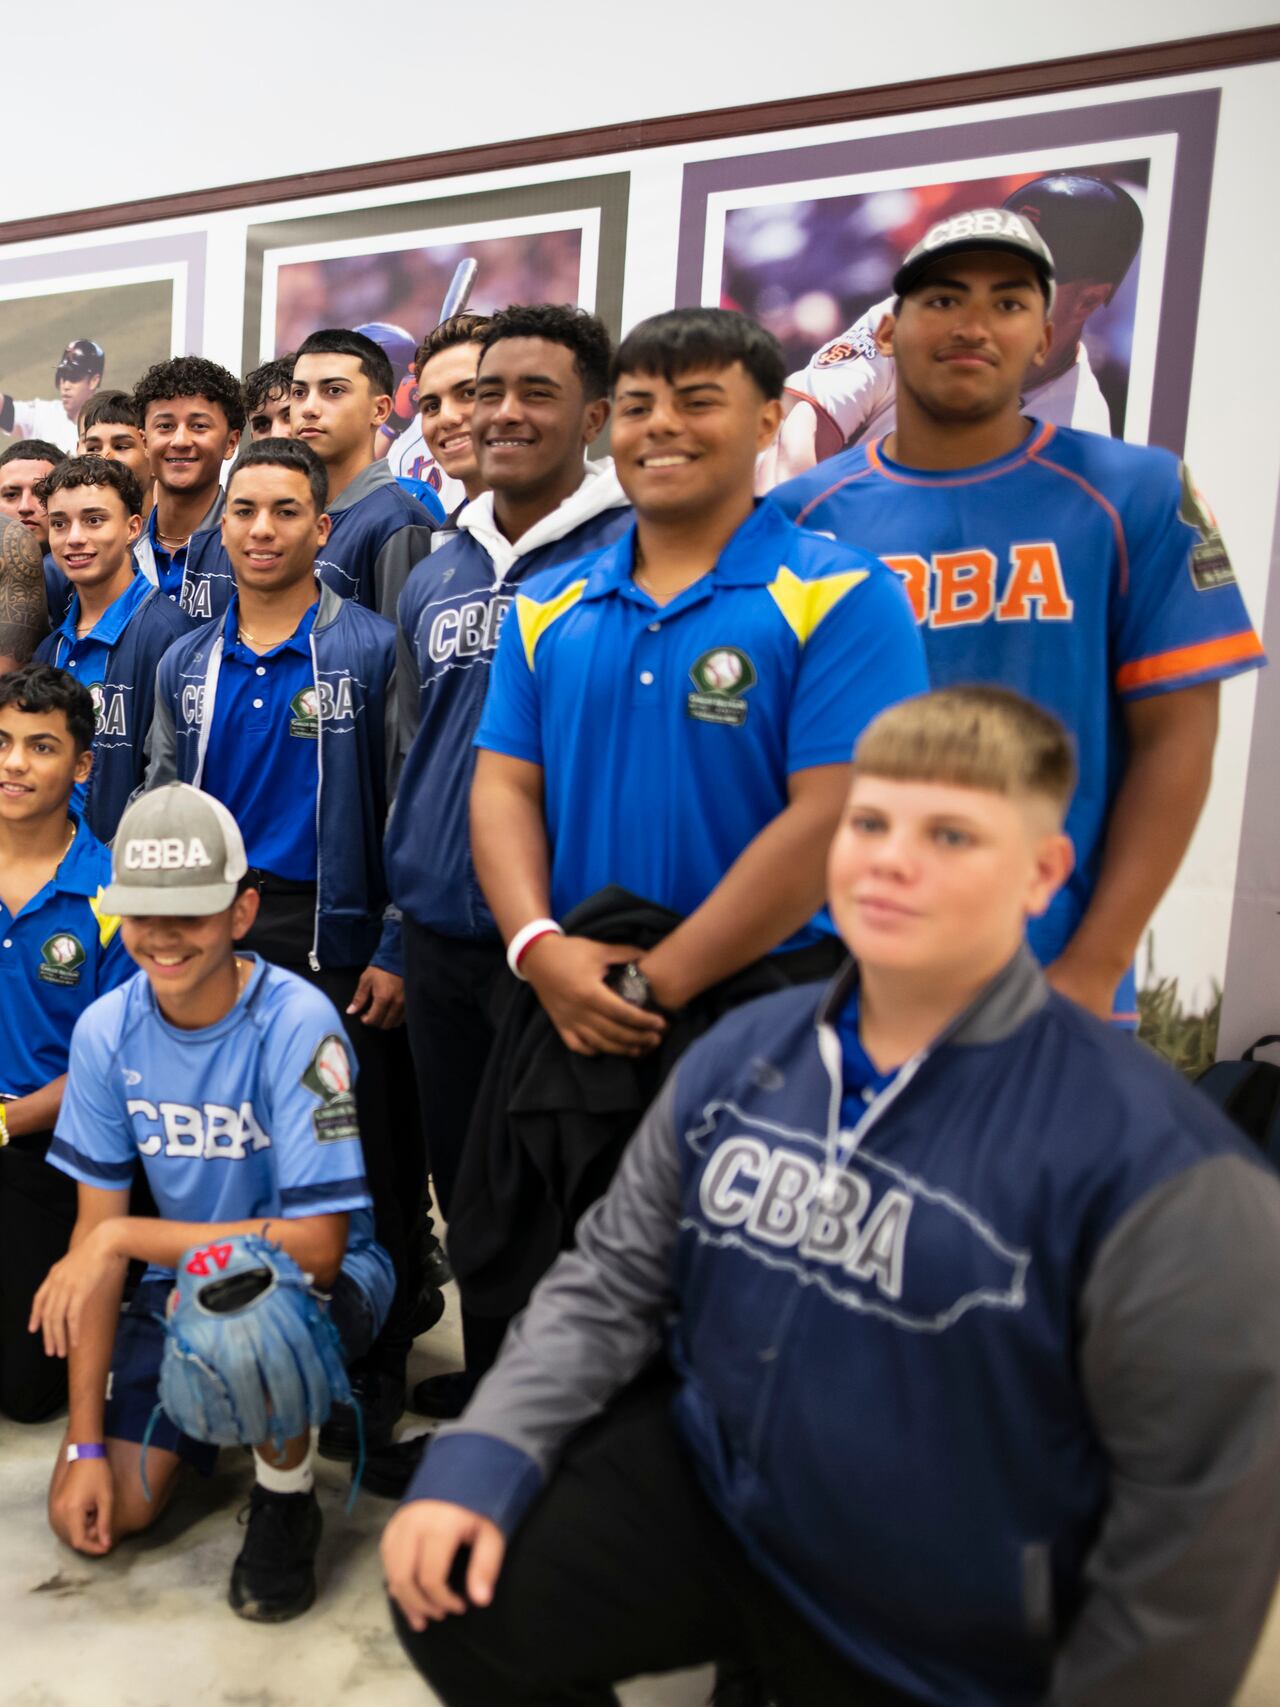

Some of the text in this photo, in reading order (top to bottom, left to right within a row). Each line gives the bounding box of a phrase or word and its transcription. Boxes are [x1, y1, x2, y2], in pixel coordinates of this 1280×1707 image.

[923, 211, 1032, 251] CBBA
[428, 595, 516, 664] CBB
[125, 837, 212, 870] CBBA
[126, 1099, 271, 1161] CBBA
[699, 1136, 914, 1300] CBBA
